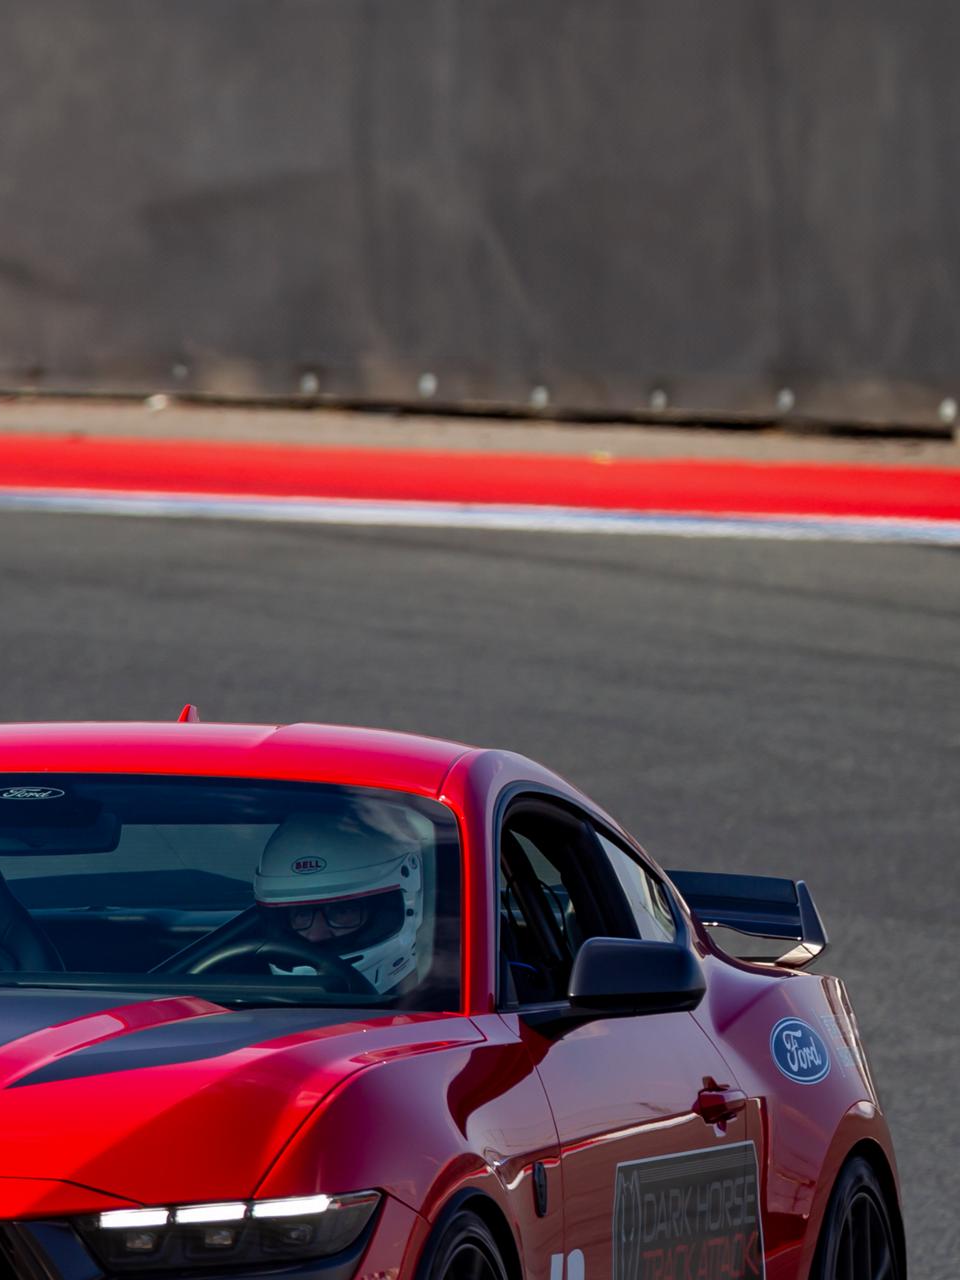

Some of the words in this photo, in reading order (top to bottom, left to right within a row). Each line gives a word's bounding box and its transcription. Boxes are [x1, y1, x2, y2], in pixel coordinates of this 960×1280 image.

[2, 788, 52, 798] Ford
[295, 860, 322, 870] BELL
[782, 1029, 822, 1072] Ford
[643, 1185, 692, 1243] DARK
[696, 1174, 756, 1233] HORSE
